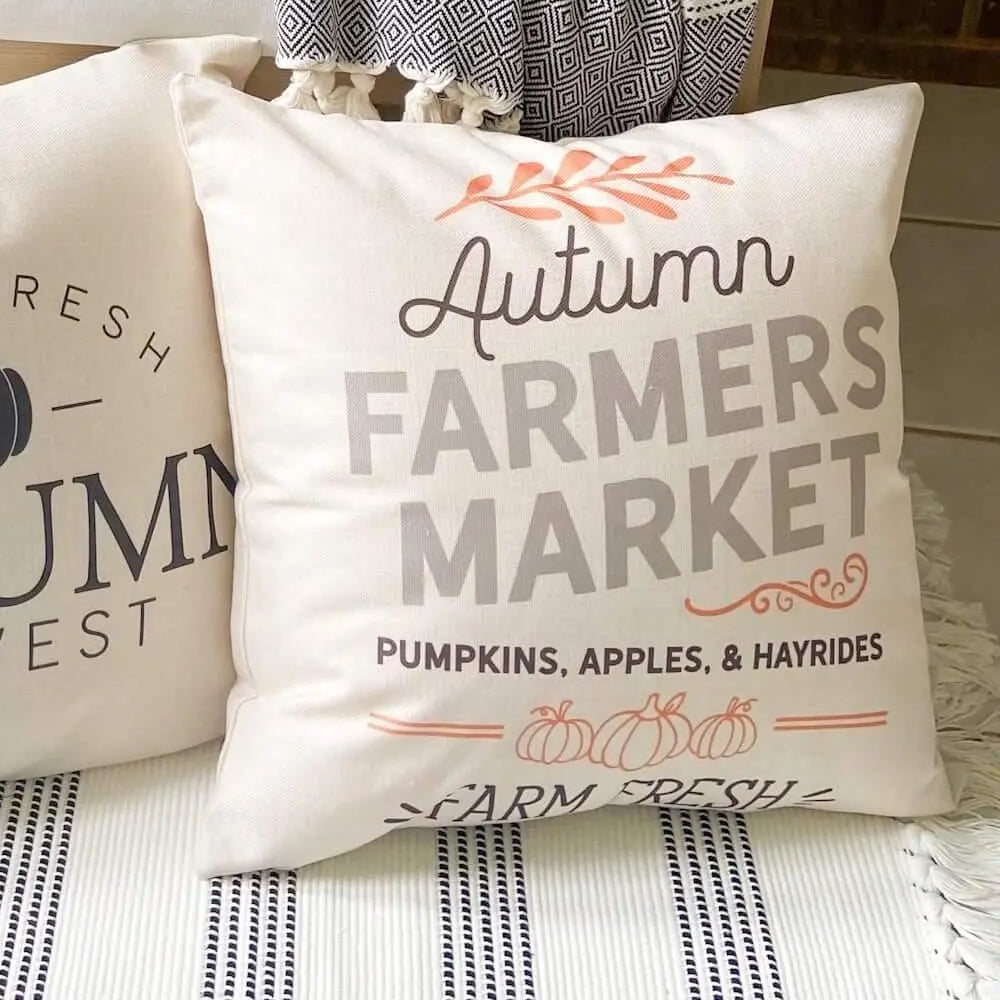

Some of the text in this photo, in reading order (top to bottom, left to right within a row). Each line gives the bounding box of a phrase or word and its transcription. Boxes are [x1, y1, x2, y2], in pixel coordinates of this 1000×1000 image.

[399, 224, 795, 361] Autumn
[344, 305, 888, 476] FARMERS
[399, 432, 881, 606] MARKET
[376, 632, 884, 678] PUMPKINS, APPLES, & HAYRIDES
[425, 777, 799, 822] FARM FRESH
